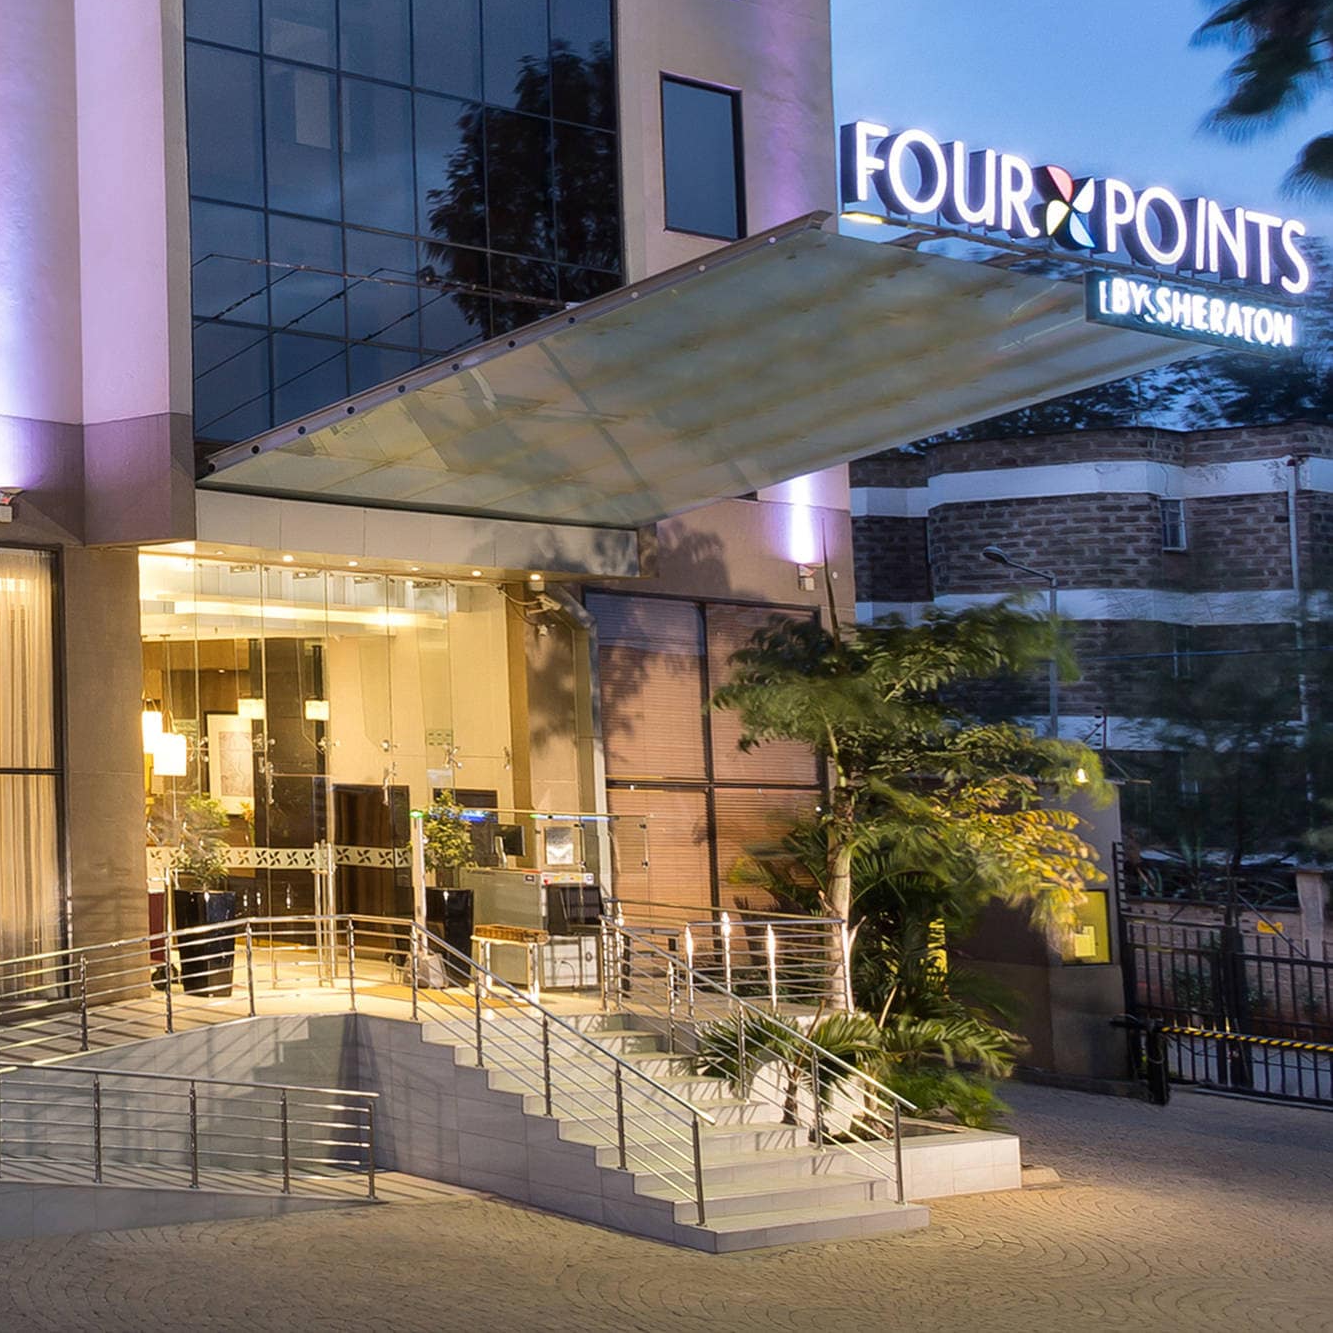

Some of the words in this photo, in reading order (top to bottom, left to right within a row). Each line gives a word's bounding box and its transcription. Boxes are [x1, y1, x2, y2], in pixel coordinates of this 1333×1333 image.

[852, 121, 1041, 238] FOUR
[1103, 177, 1310, 294] POINTS
[1111, 277, 1148, 315] BY
[1155, 286, 1293, 347] SHERATON
